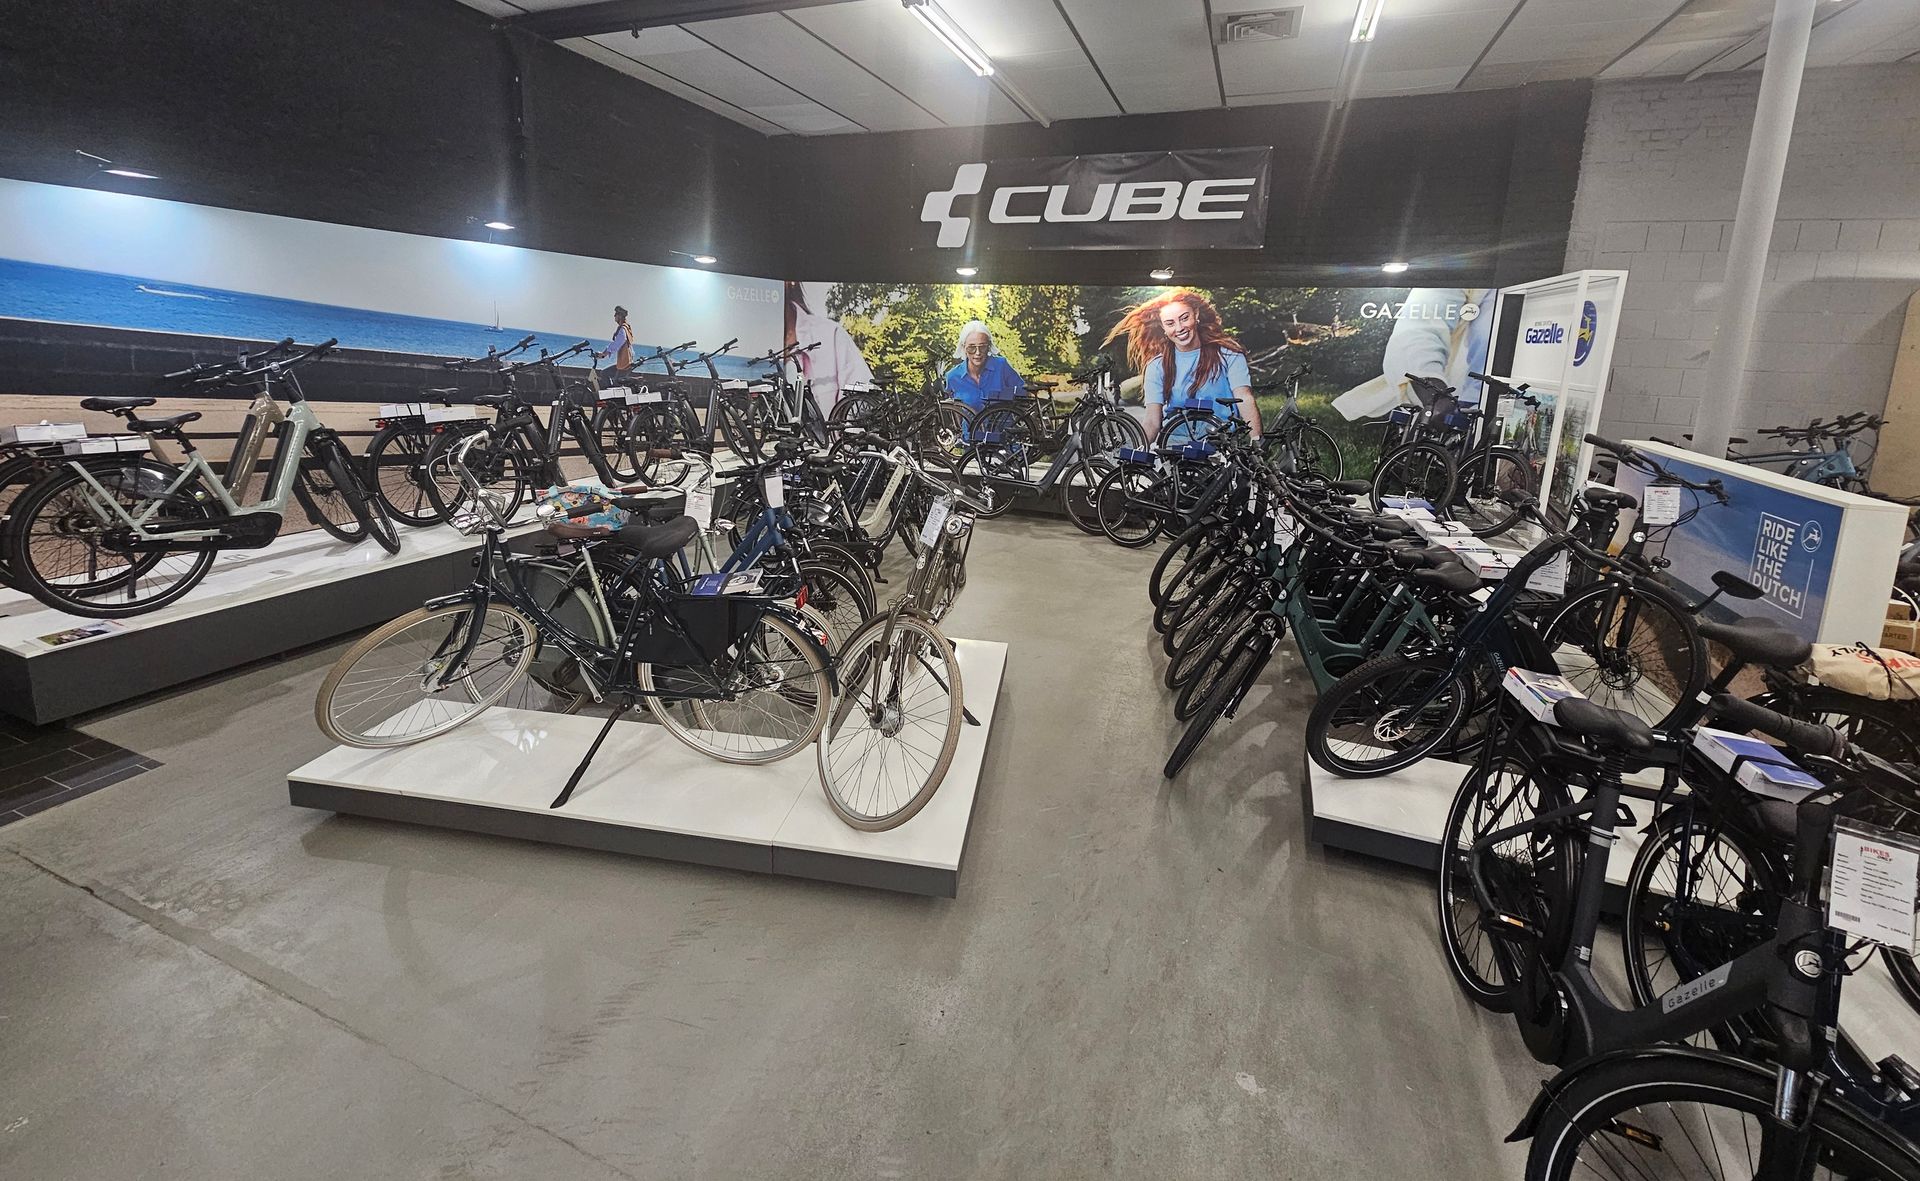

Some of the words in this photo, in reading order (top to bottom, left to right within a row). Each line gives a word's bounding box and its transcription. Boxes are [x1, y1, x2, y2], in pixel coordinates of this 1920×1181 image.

[988, 178, 1256, 224] CUBE
[727, 286, 771, 303] GAZELLE
[1360, 302, 1457, 320] GAZELLE
[1525, 323, 1564, 344] Gazelle
[1762, 519, 1796, 546] RIDE
[1758, 536, 1789, 563] LIKE
[1757, 554, 1783, 580] THE
[1752, 571, 1802, 609] DUTCH
[1668, 978, 1716, 1008] Gazelle
